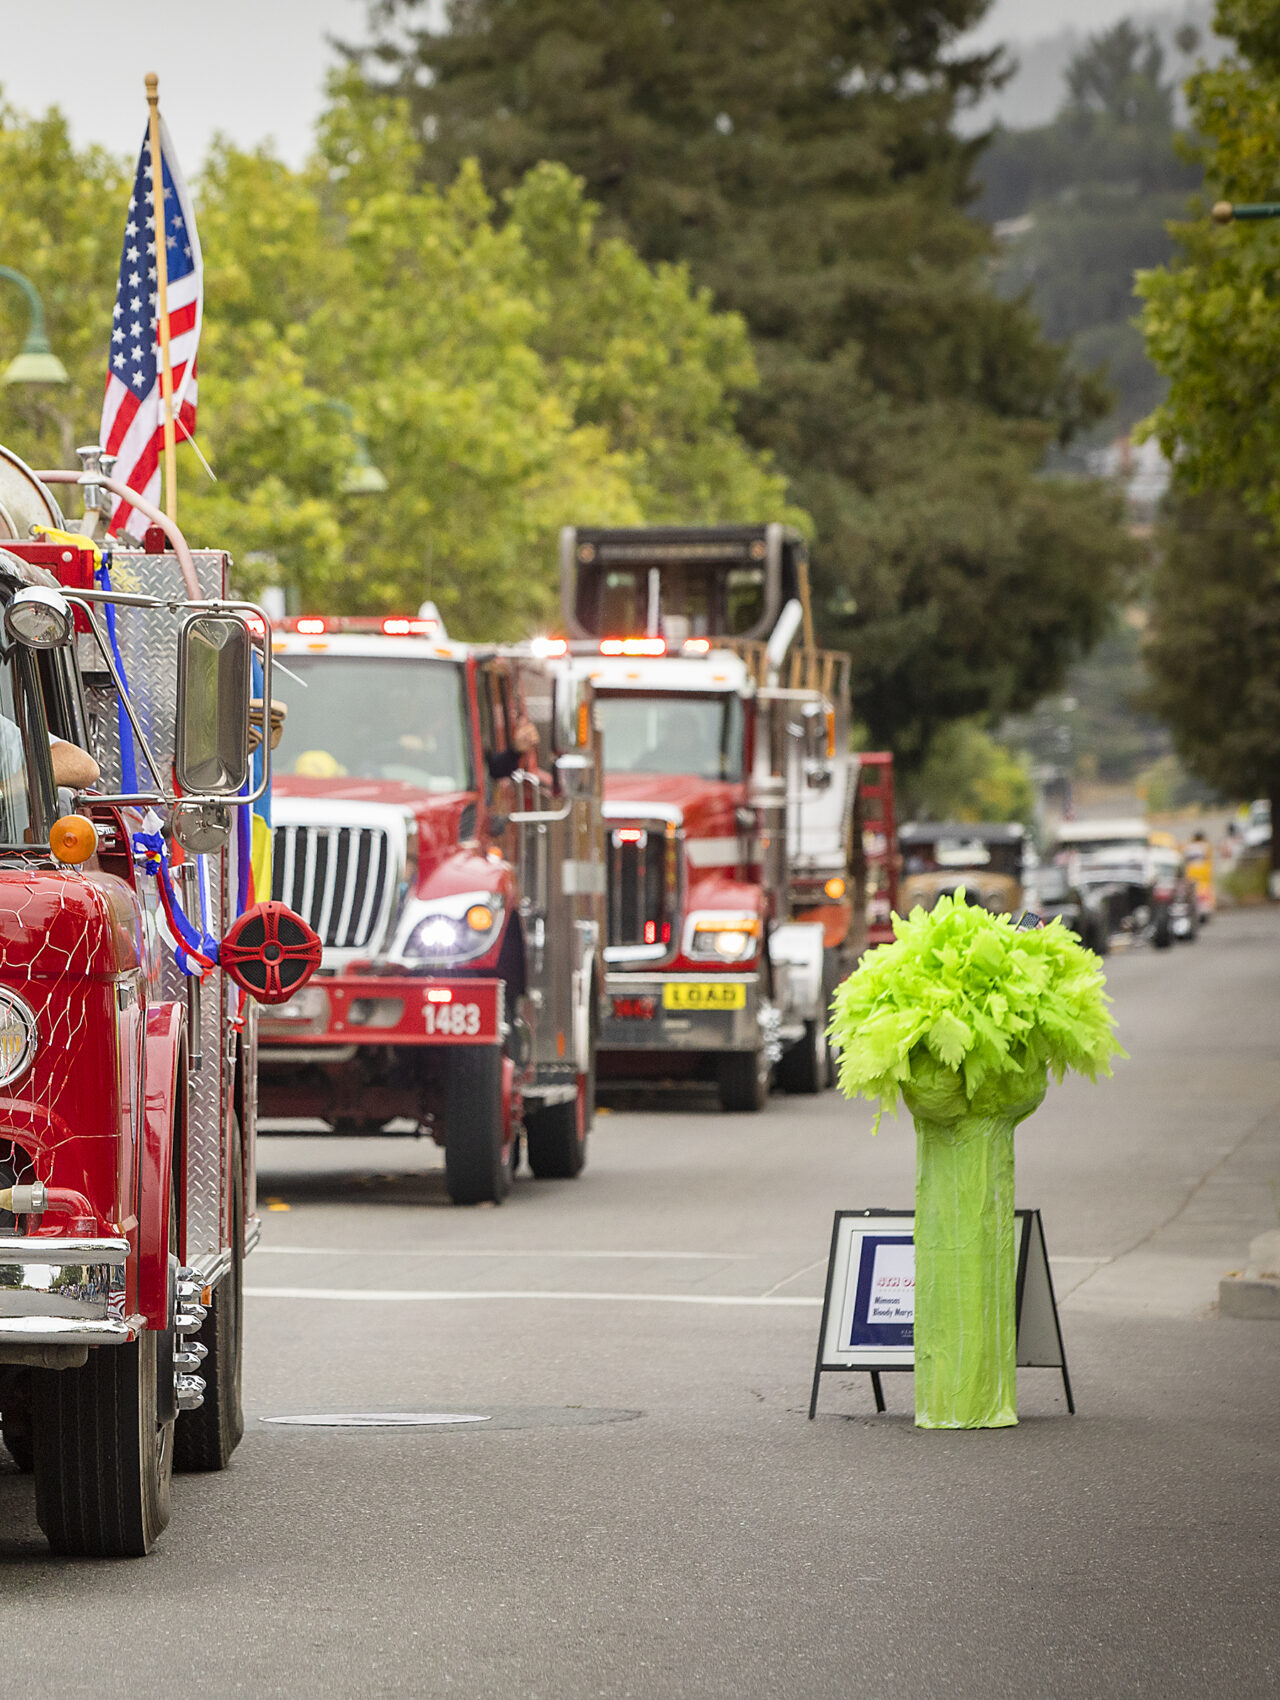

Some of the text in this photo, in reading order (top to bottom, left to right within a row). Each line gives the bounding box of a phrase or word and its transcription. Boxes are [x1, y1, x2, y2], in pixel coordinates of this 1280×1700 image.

[672, 989, 737, 1002] LOAD
[422, 1003, 482, 1035] 1483
[872, 1307, 893, 1318] Bloody
